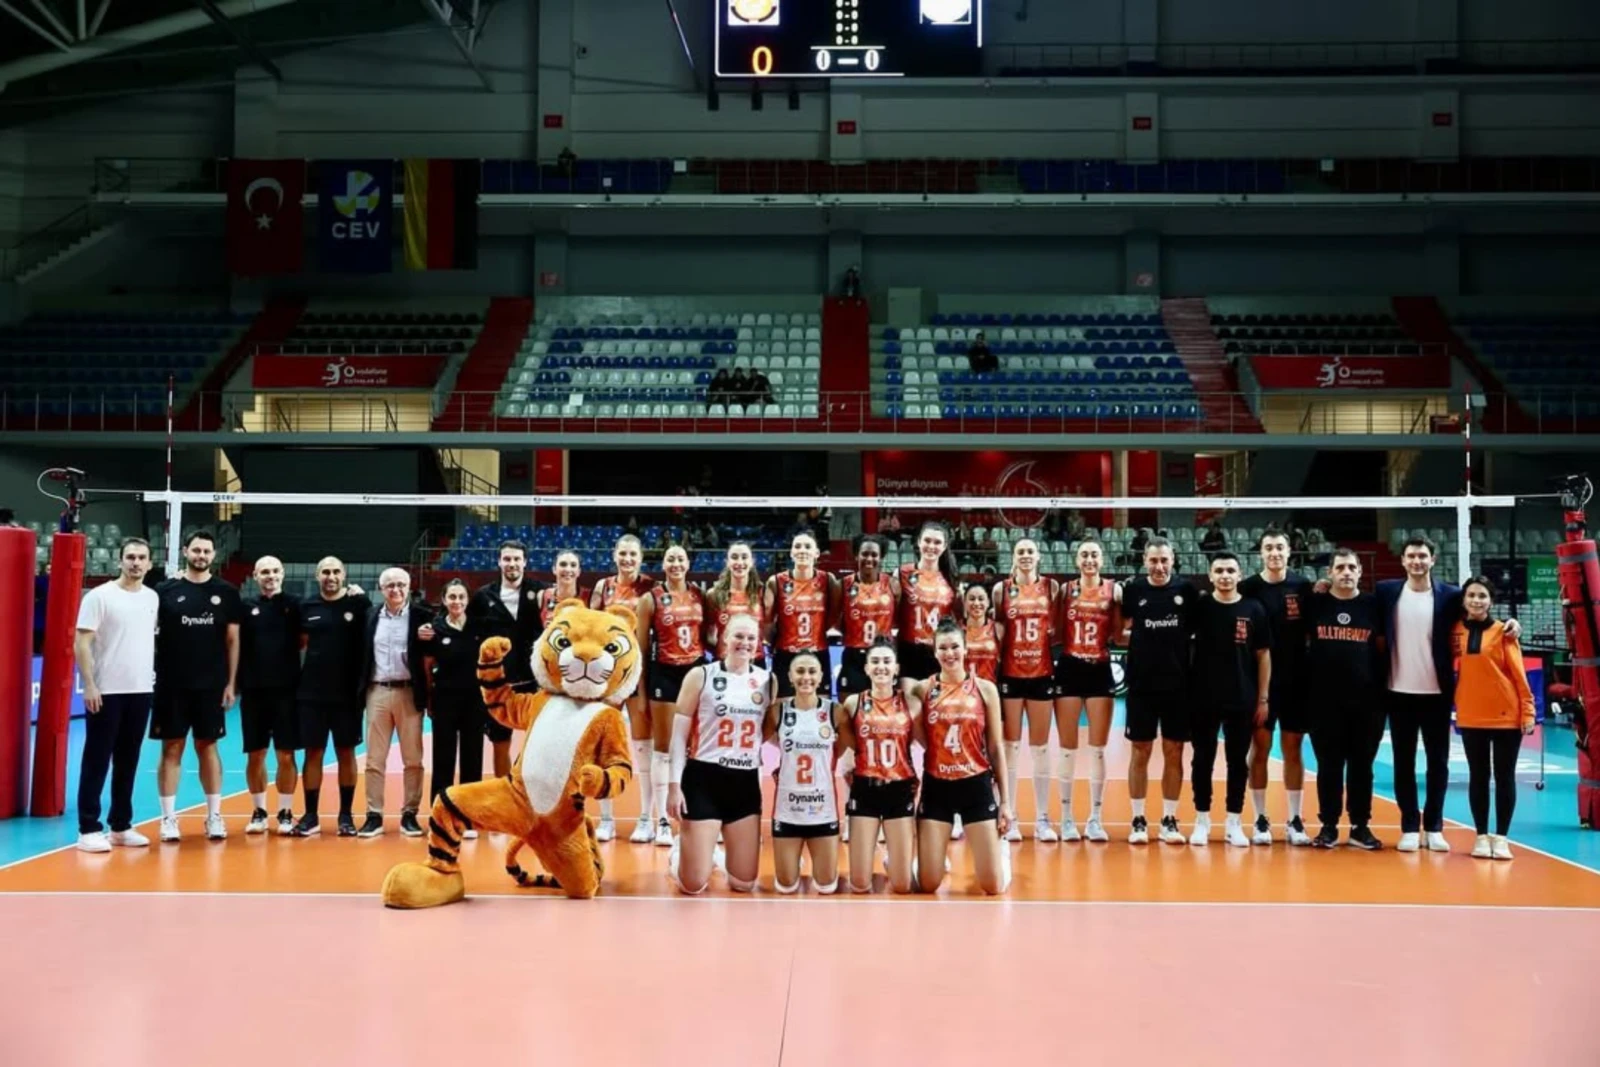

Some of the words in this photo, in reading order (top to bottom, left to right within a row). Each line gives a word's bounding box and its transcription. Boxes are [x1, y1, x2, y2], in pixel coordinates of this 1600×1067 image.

[752, 46, 773, 74] 0
[331, 221, 381, 239] CEV
[877, 479, 908, 490] Dünya
[910, 479, 948, 490] duysun
[181, 613, 214, 626] Dynavit
[797, 612, 811, 637] 3
[1014, 617, 1040, 642] 15
[1145, 615, 1178, 629] Dynavit
[677, 625, 691, 649] 9
[1074, 620, 1098, 646] 12
[717, 718, 756, 748] 22
[943, 724, 962, 754] 4
[718, 754, 753, 769] Dynavit
[865, 738, 897, 769] 10
[796, 754, 813, 784] 2
[788, 790, 825, 805] Dynavit
